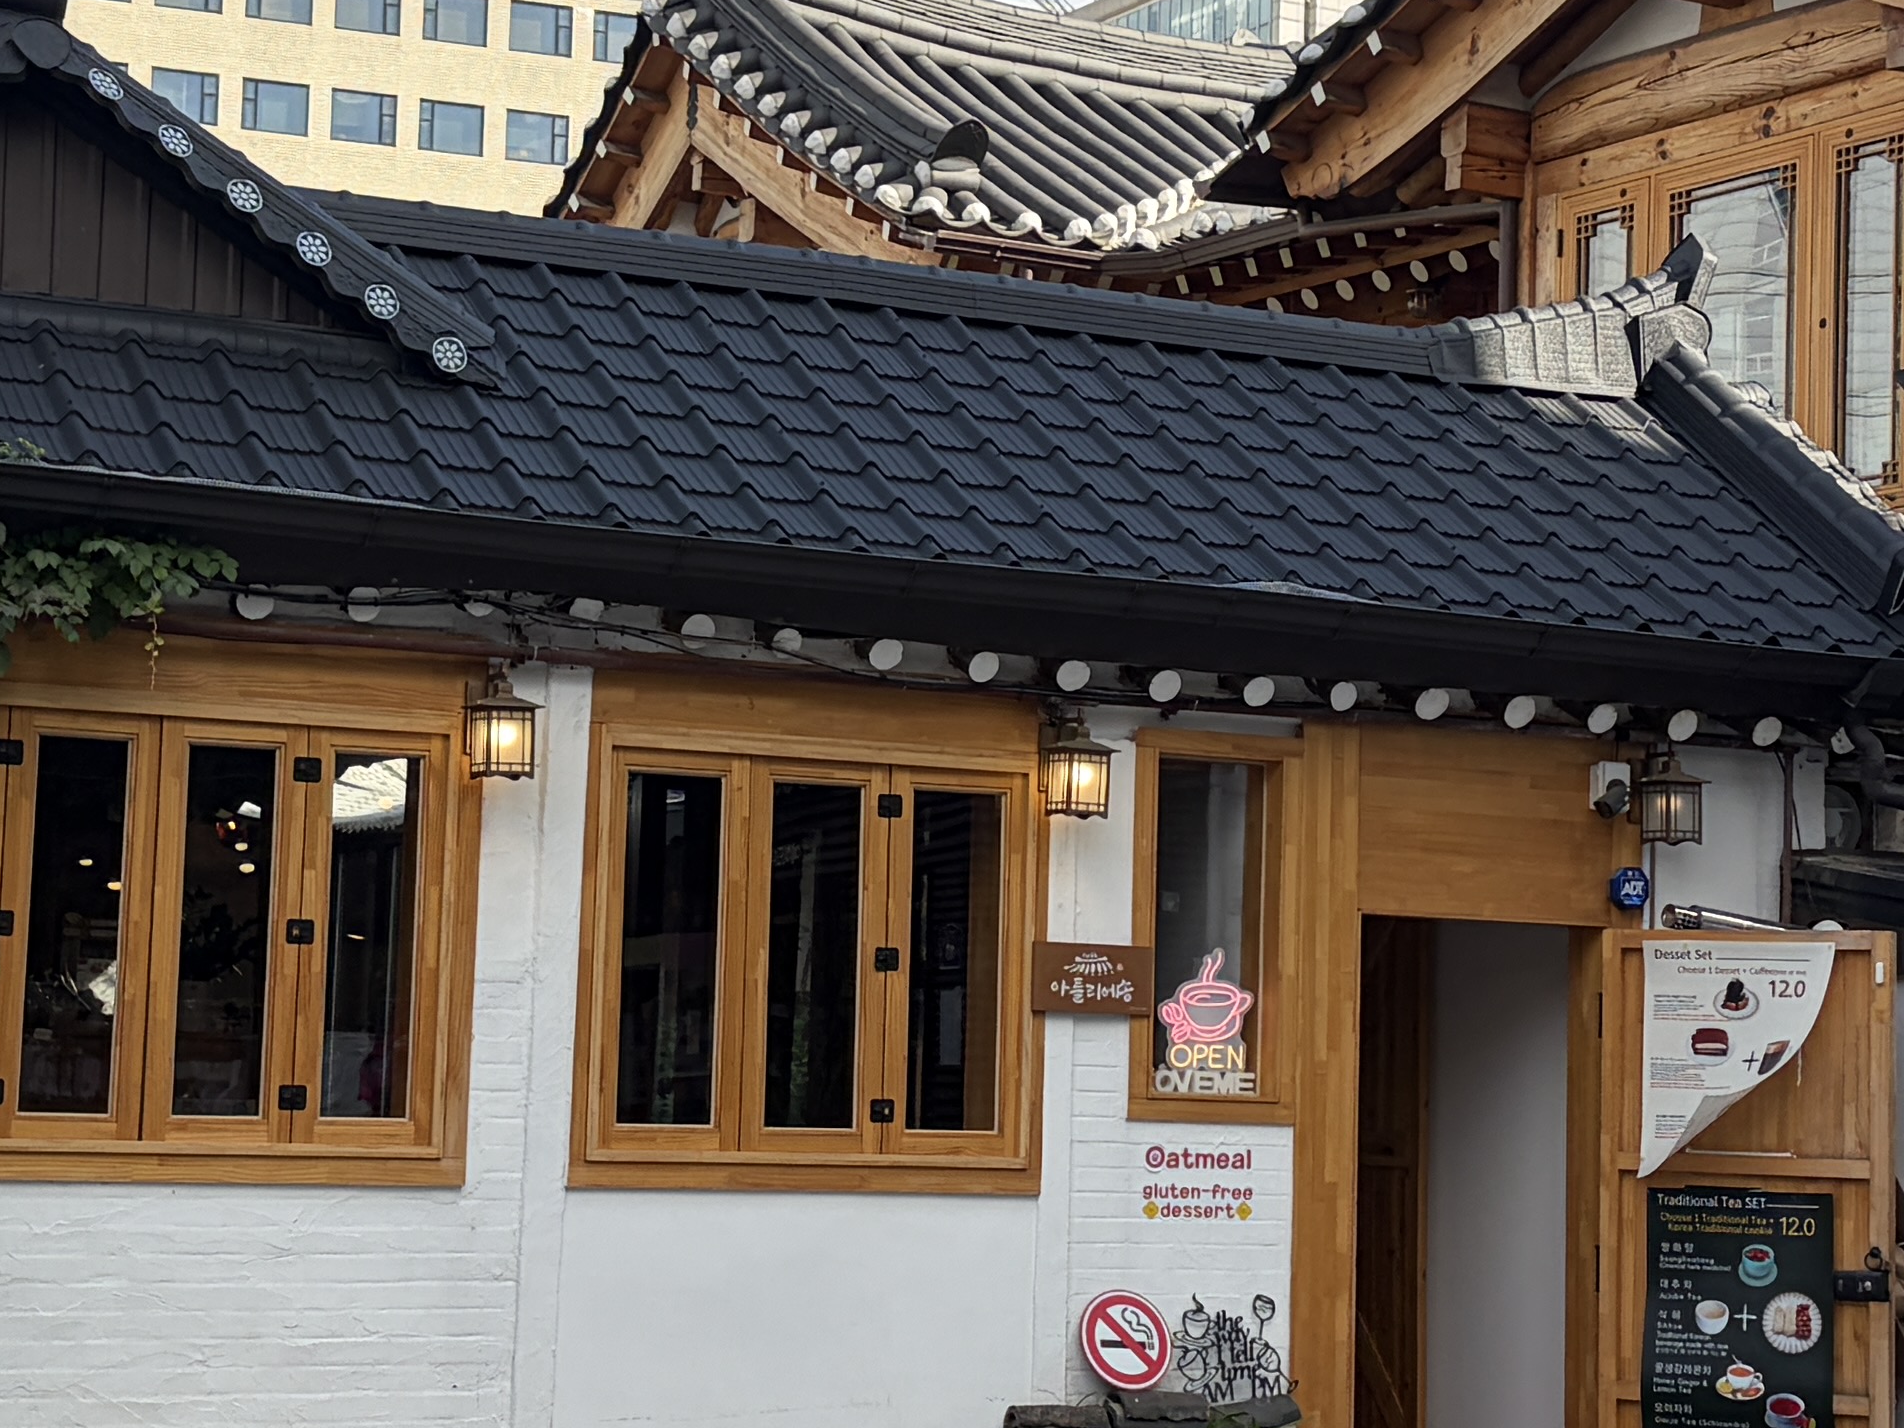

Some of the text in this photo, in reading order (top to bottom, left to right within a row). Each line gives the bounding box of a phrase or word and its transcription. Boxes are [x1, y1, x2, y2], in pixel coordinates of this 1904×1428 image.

[1621, 881, 1645, 895] ADT
[1694, 949, 1713, 961] Set
[1768, 979, 1807, 999] 12.0
[1169, 1043, 1245, 1070] OPEN
[1145, 1145, 1252, 1170] Oatmeal
[1142, 1183, 1254, 1201] gluten-free
[1657, 1193, 1768, 1209] Traditional Tea SET
[1160, 1202, 1235, 1219] dessert
[1778, 1216, 1816, 1237] 12.0
[1216, 1309, 1244, 1331] the
